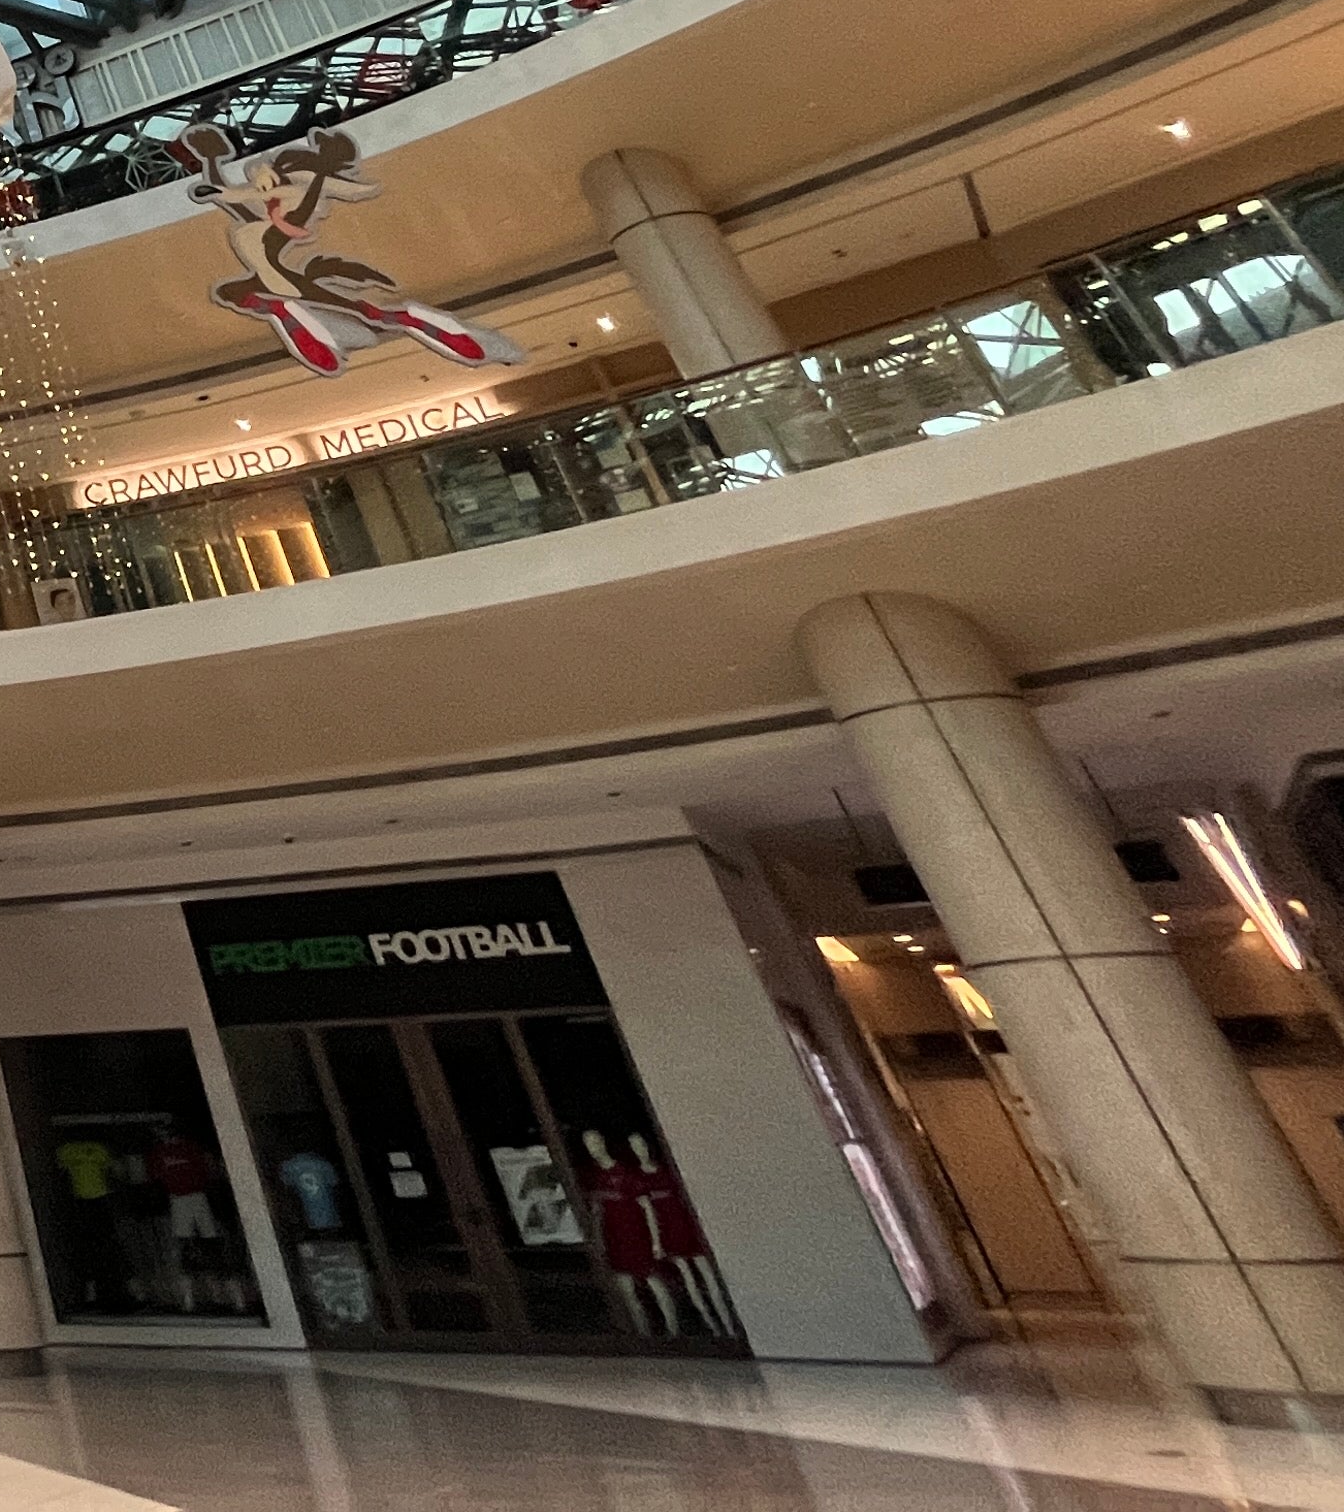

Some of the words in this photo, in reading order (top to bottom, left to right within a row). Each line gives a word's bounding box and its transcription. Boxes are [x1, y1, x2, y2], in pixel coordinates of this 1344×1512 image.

[84, 445, 292, 509] CRAWFURD
[320, 396, 506, 461] MEDICAL
[368, 921, 571, 967] FOOTBALL
